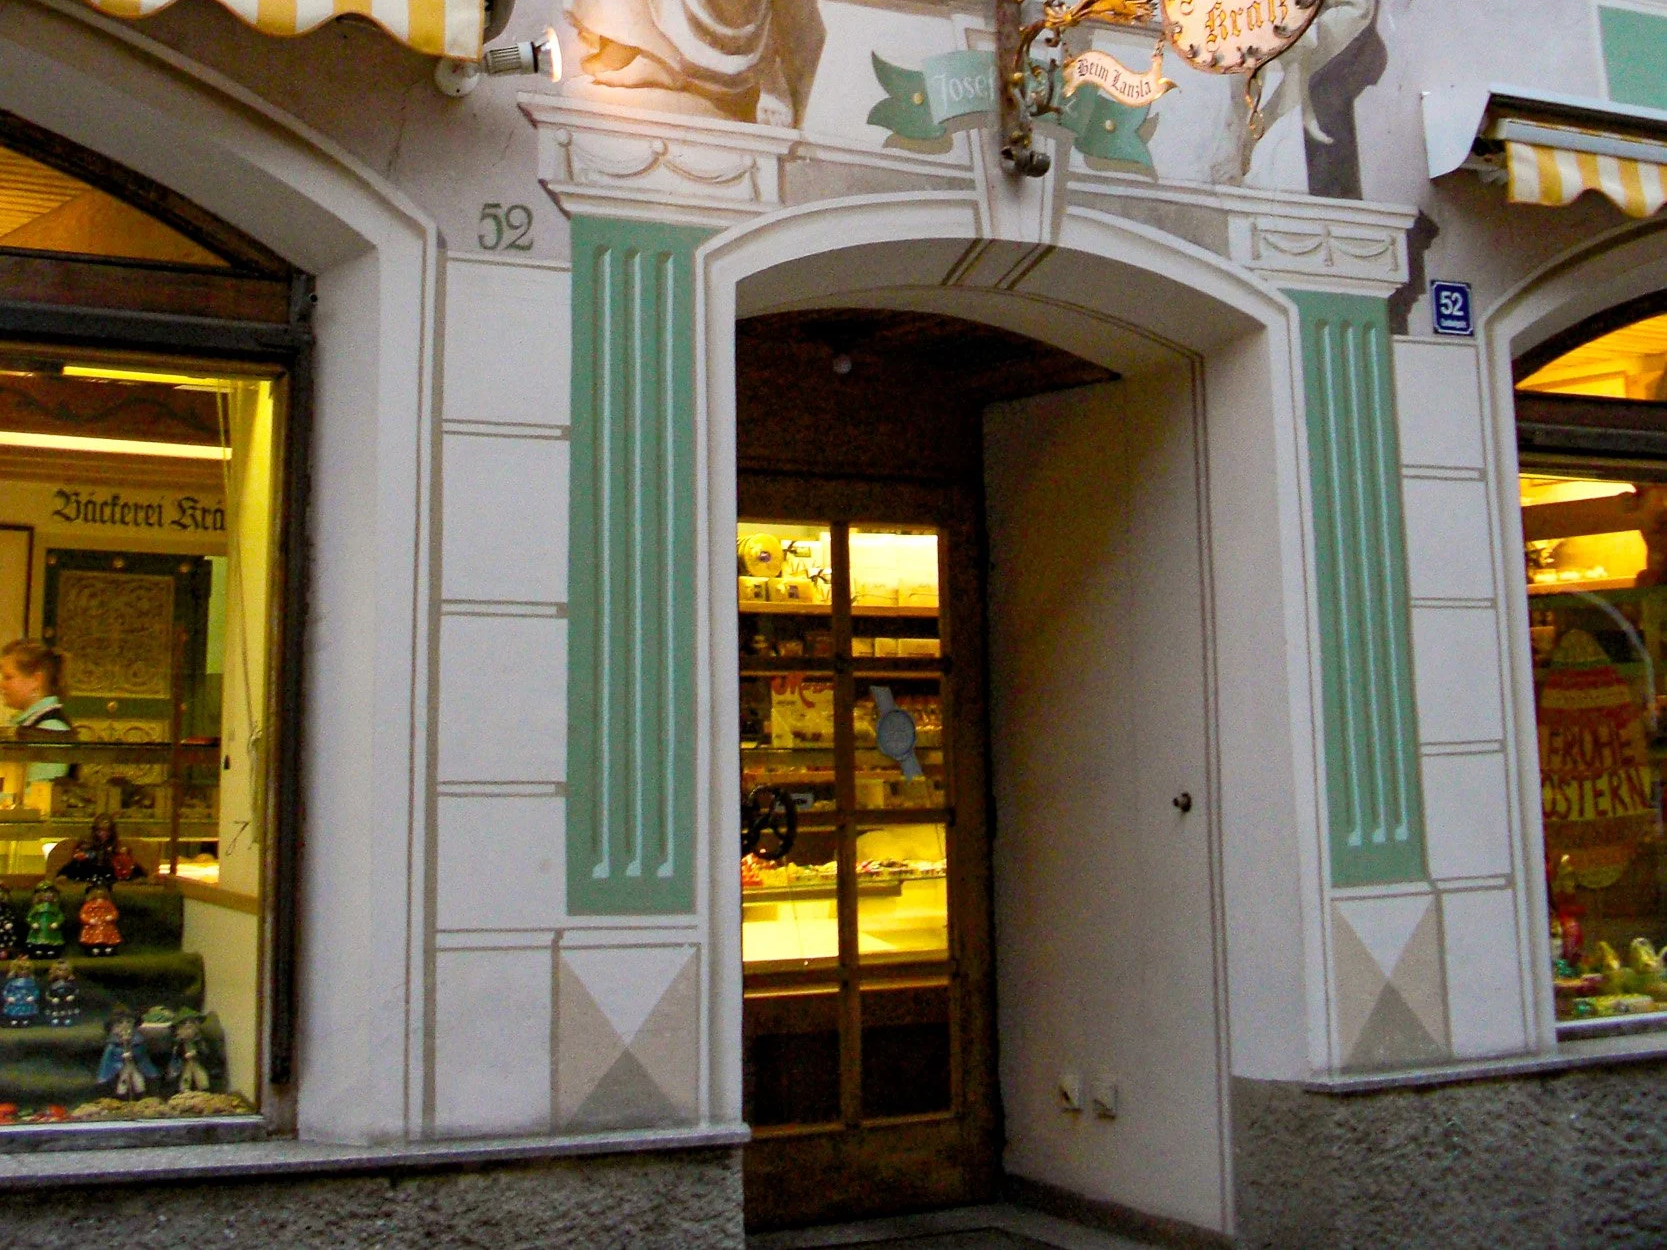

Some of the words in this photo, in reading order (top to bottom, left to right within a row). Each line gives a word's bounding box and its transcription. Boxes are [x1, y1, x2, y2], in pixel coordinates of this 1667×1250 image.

[1077, 59, 1109, 81] Beim
[1110, 66, 1151, 100] Lanzla
[478, 202, 534, 251] 52
[1440, 291, 1464, 316] 52
[52, 488, 164, 528] Bäckerei
[1547, 724, 1635, 769] FROHE
[1541, 768, 1650, 819] OSTERN
